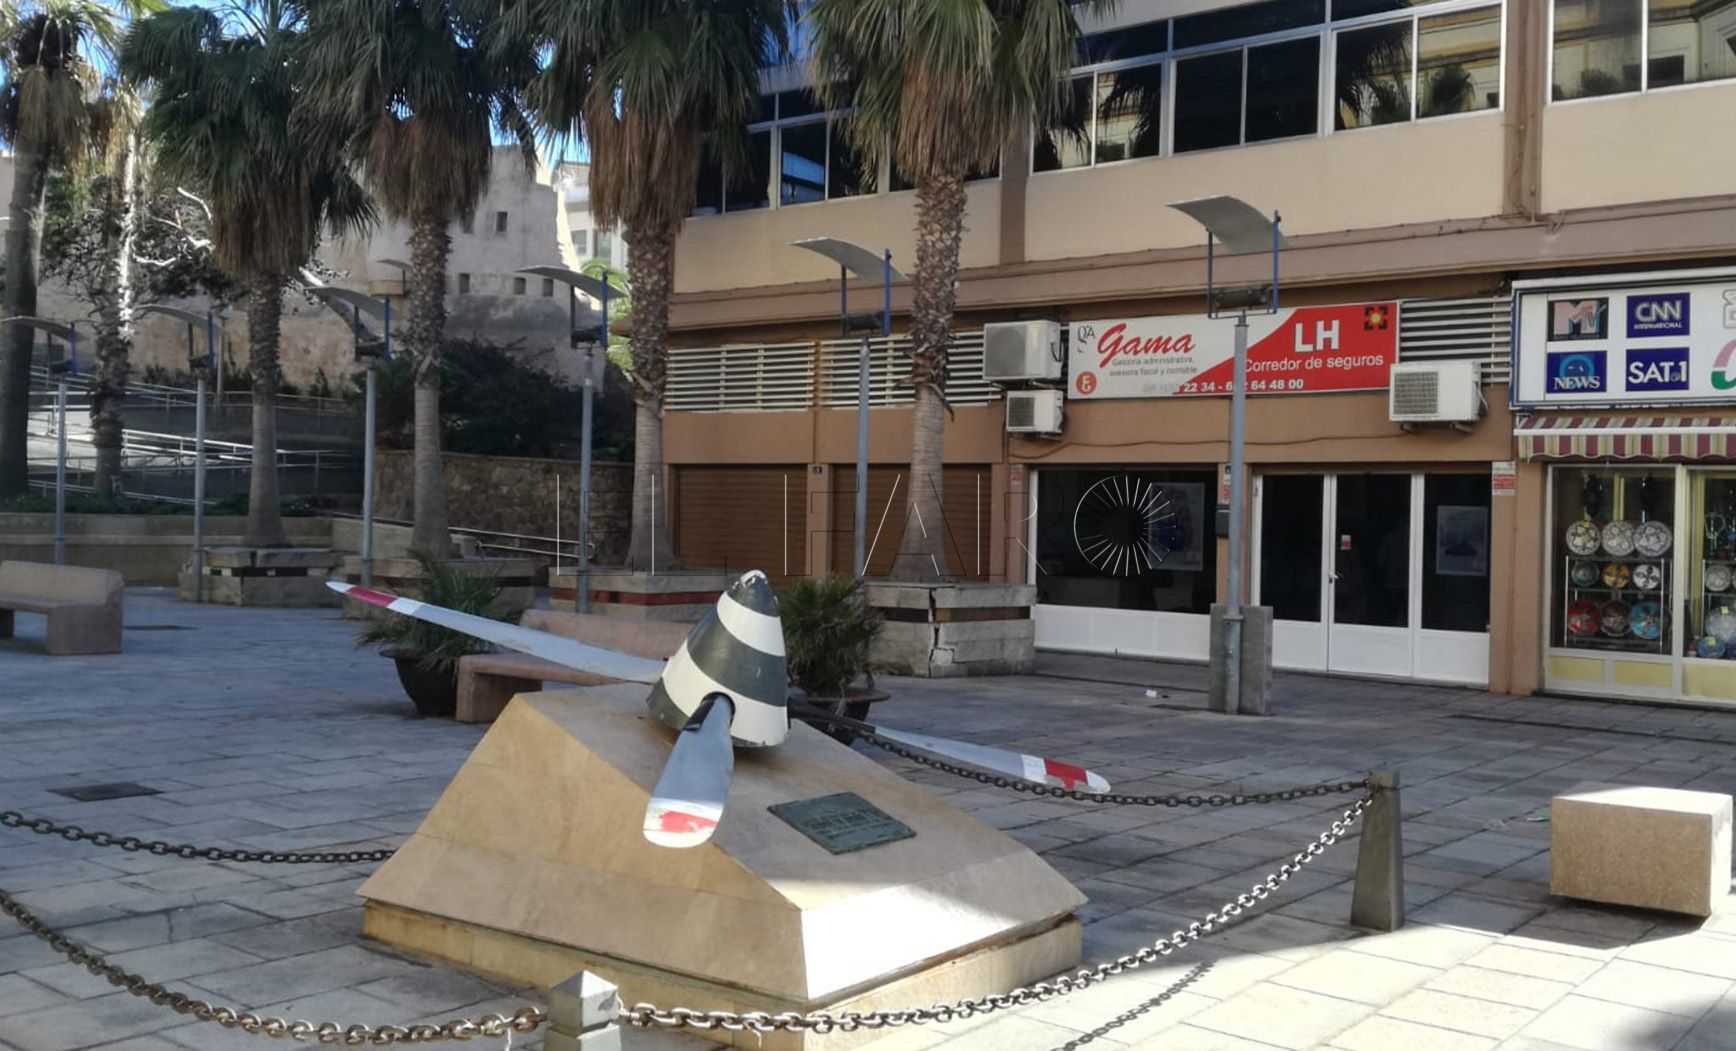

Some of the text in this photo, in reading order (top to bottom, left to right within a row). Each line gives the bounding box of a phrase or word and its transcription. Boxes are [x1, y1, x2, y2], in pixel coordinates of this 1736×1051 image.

[1554, 299, 1607, 335] MTV
[1635, 300, 1682, 322] CNN
[1097, 322, 1196, 368] Gama
[1295, 319, 1340, 353] LH
[1246, 354, 1384, 372] Corredor de seguros
[1183, 382, 1198, 393] 22
[1200, 382, 1216, 393] 34
[1251, 380, 1267, 391] 64
[1269, 380, 1285, 390] 48
[1288, 379, 1304, 389] 00
[1554, 375, 1601, 390] NEWS
